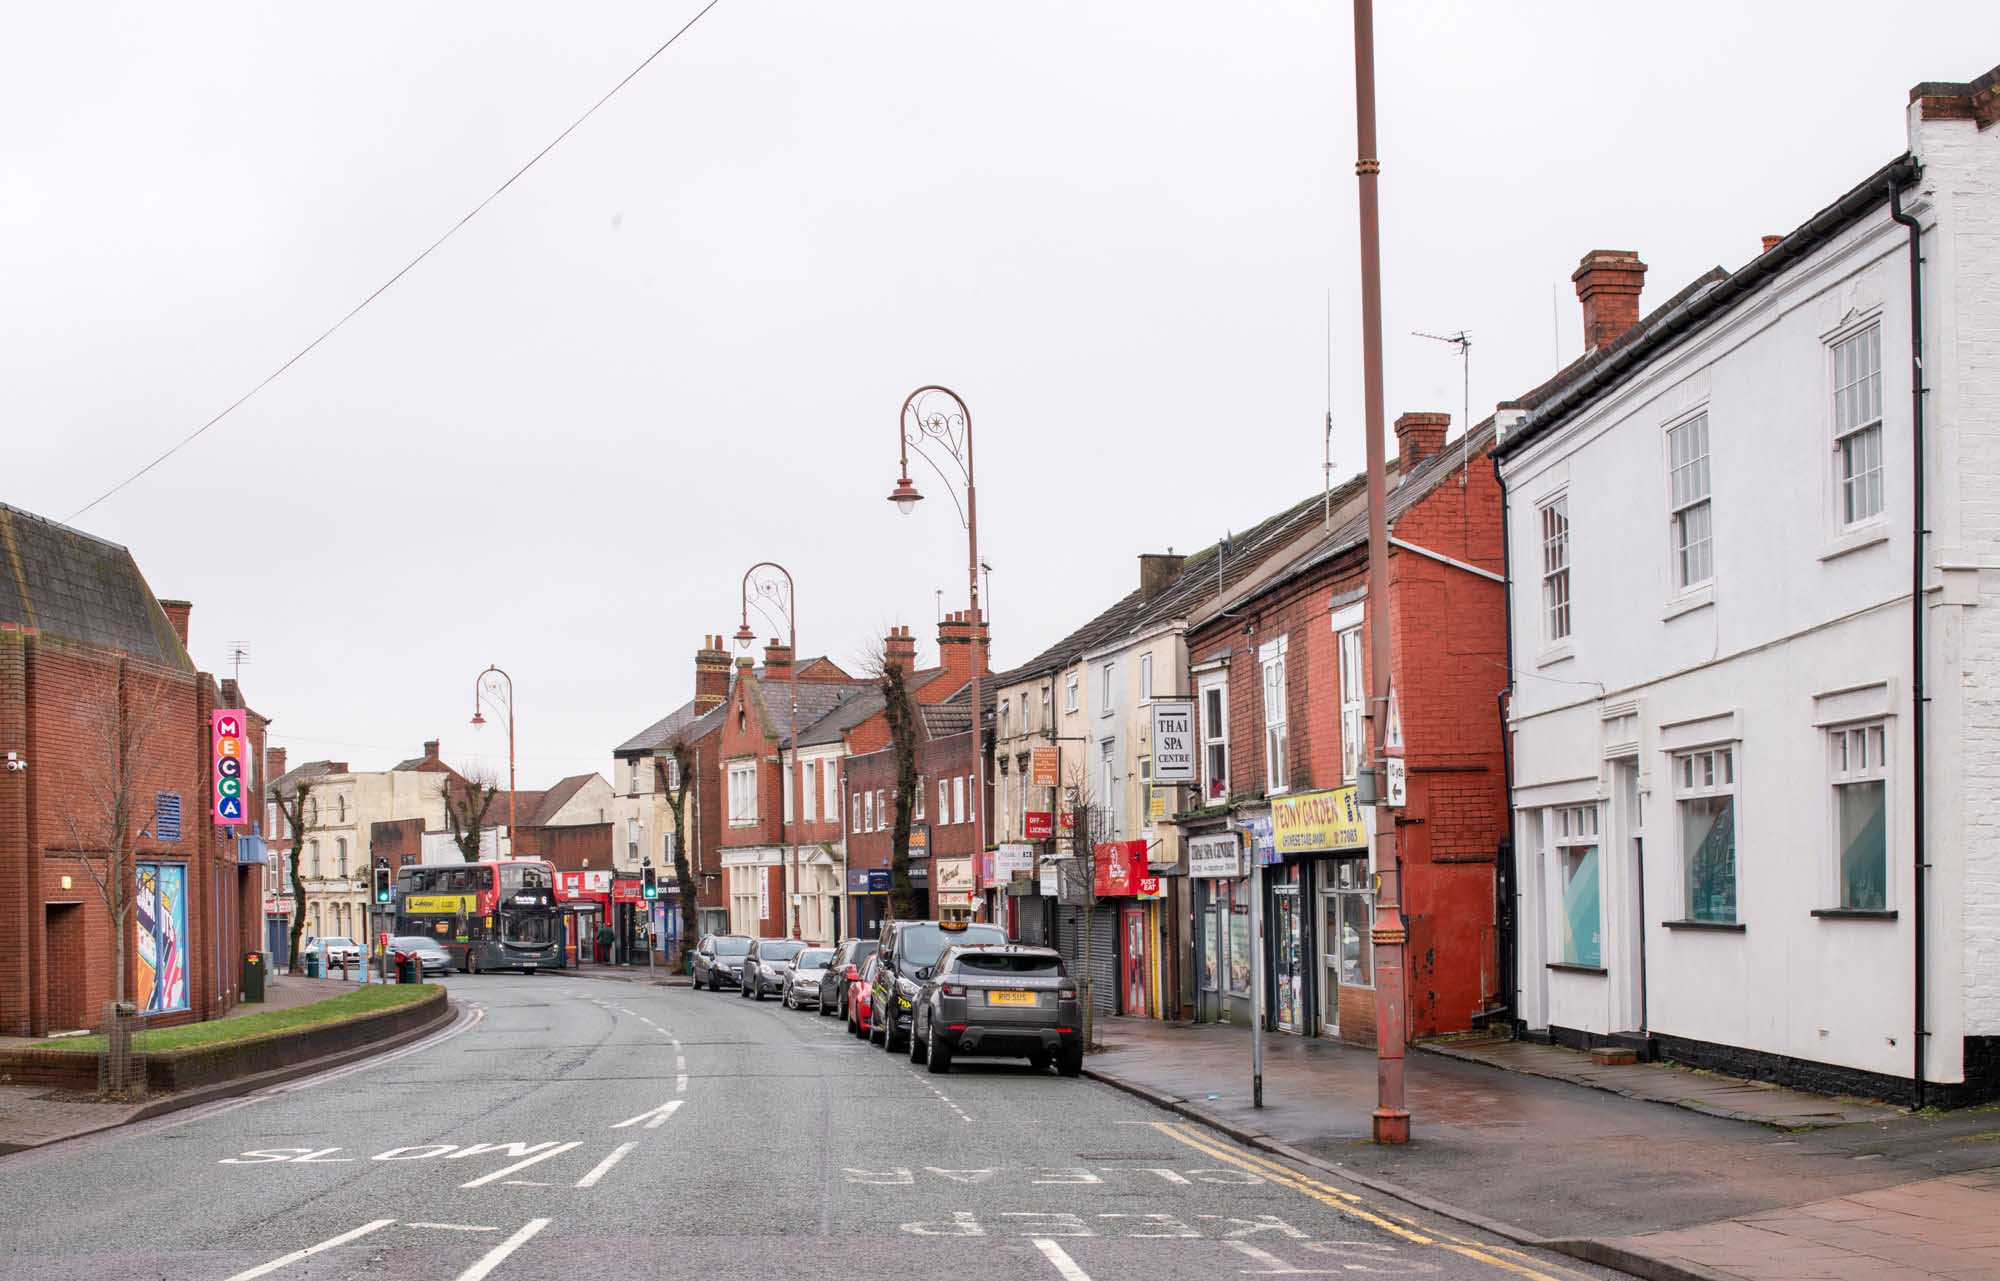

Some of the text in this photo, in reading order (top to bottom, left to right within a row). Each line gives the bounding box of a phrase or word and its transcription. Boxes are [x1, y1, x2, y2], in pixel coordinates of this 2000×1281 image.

[1158, 719, 1188, 733] THAI
[1164, 736, 1183, 750] SPA
[221, 720, 238, 815] MECCA
[1158, 753, 1191, 763] CENTRE
[1274, 798, 1301, 831] PEONY
[1302, 796, 1340, 828] GARDEN
[1029, 826, 1053, 834] LICENCE
[1191, 840, 1236, 860] THAI SPA CENTRE
[1140, 878, 1156, 886] JUST
[218, 1141, 562, 1163] SLOW
[842, 1166, 1267, 1185] CLEAR
[899, 1211, 1311, 1238] KEEP
